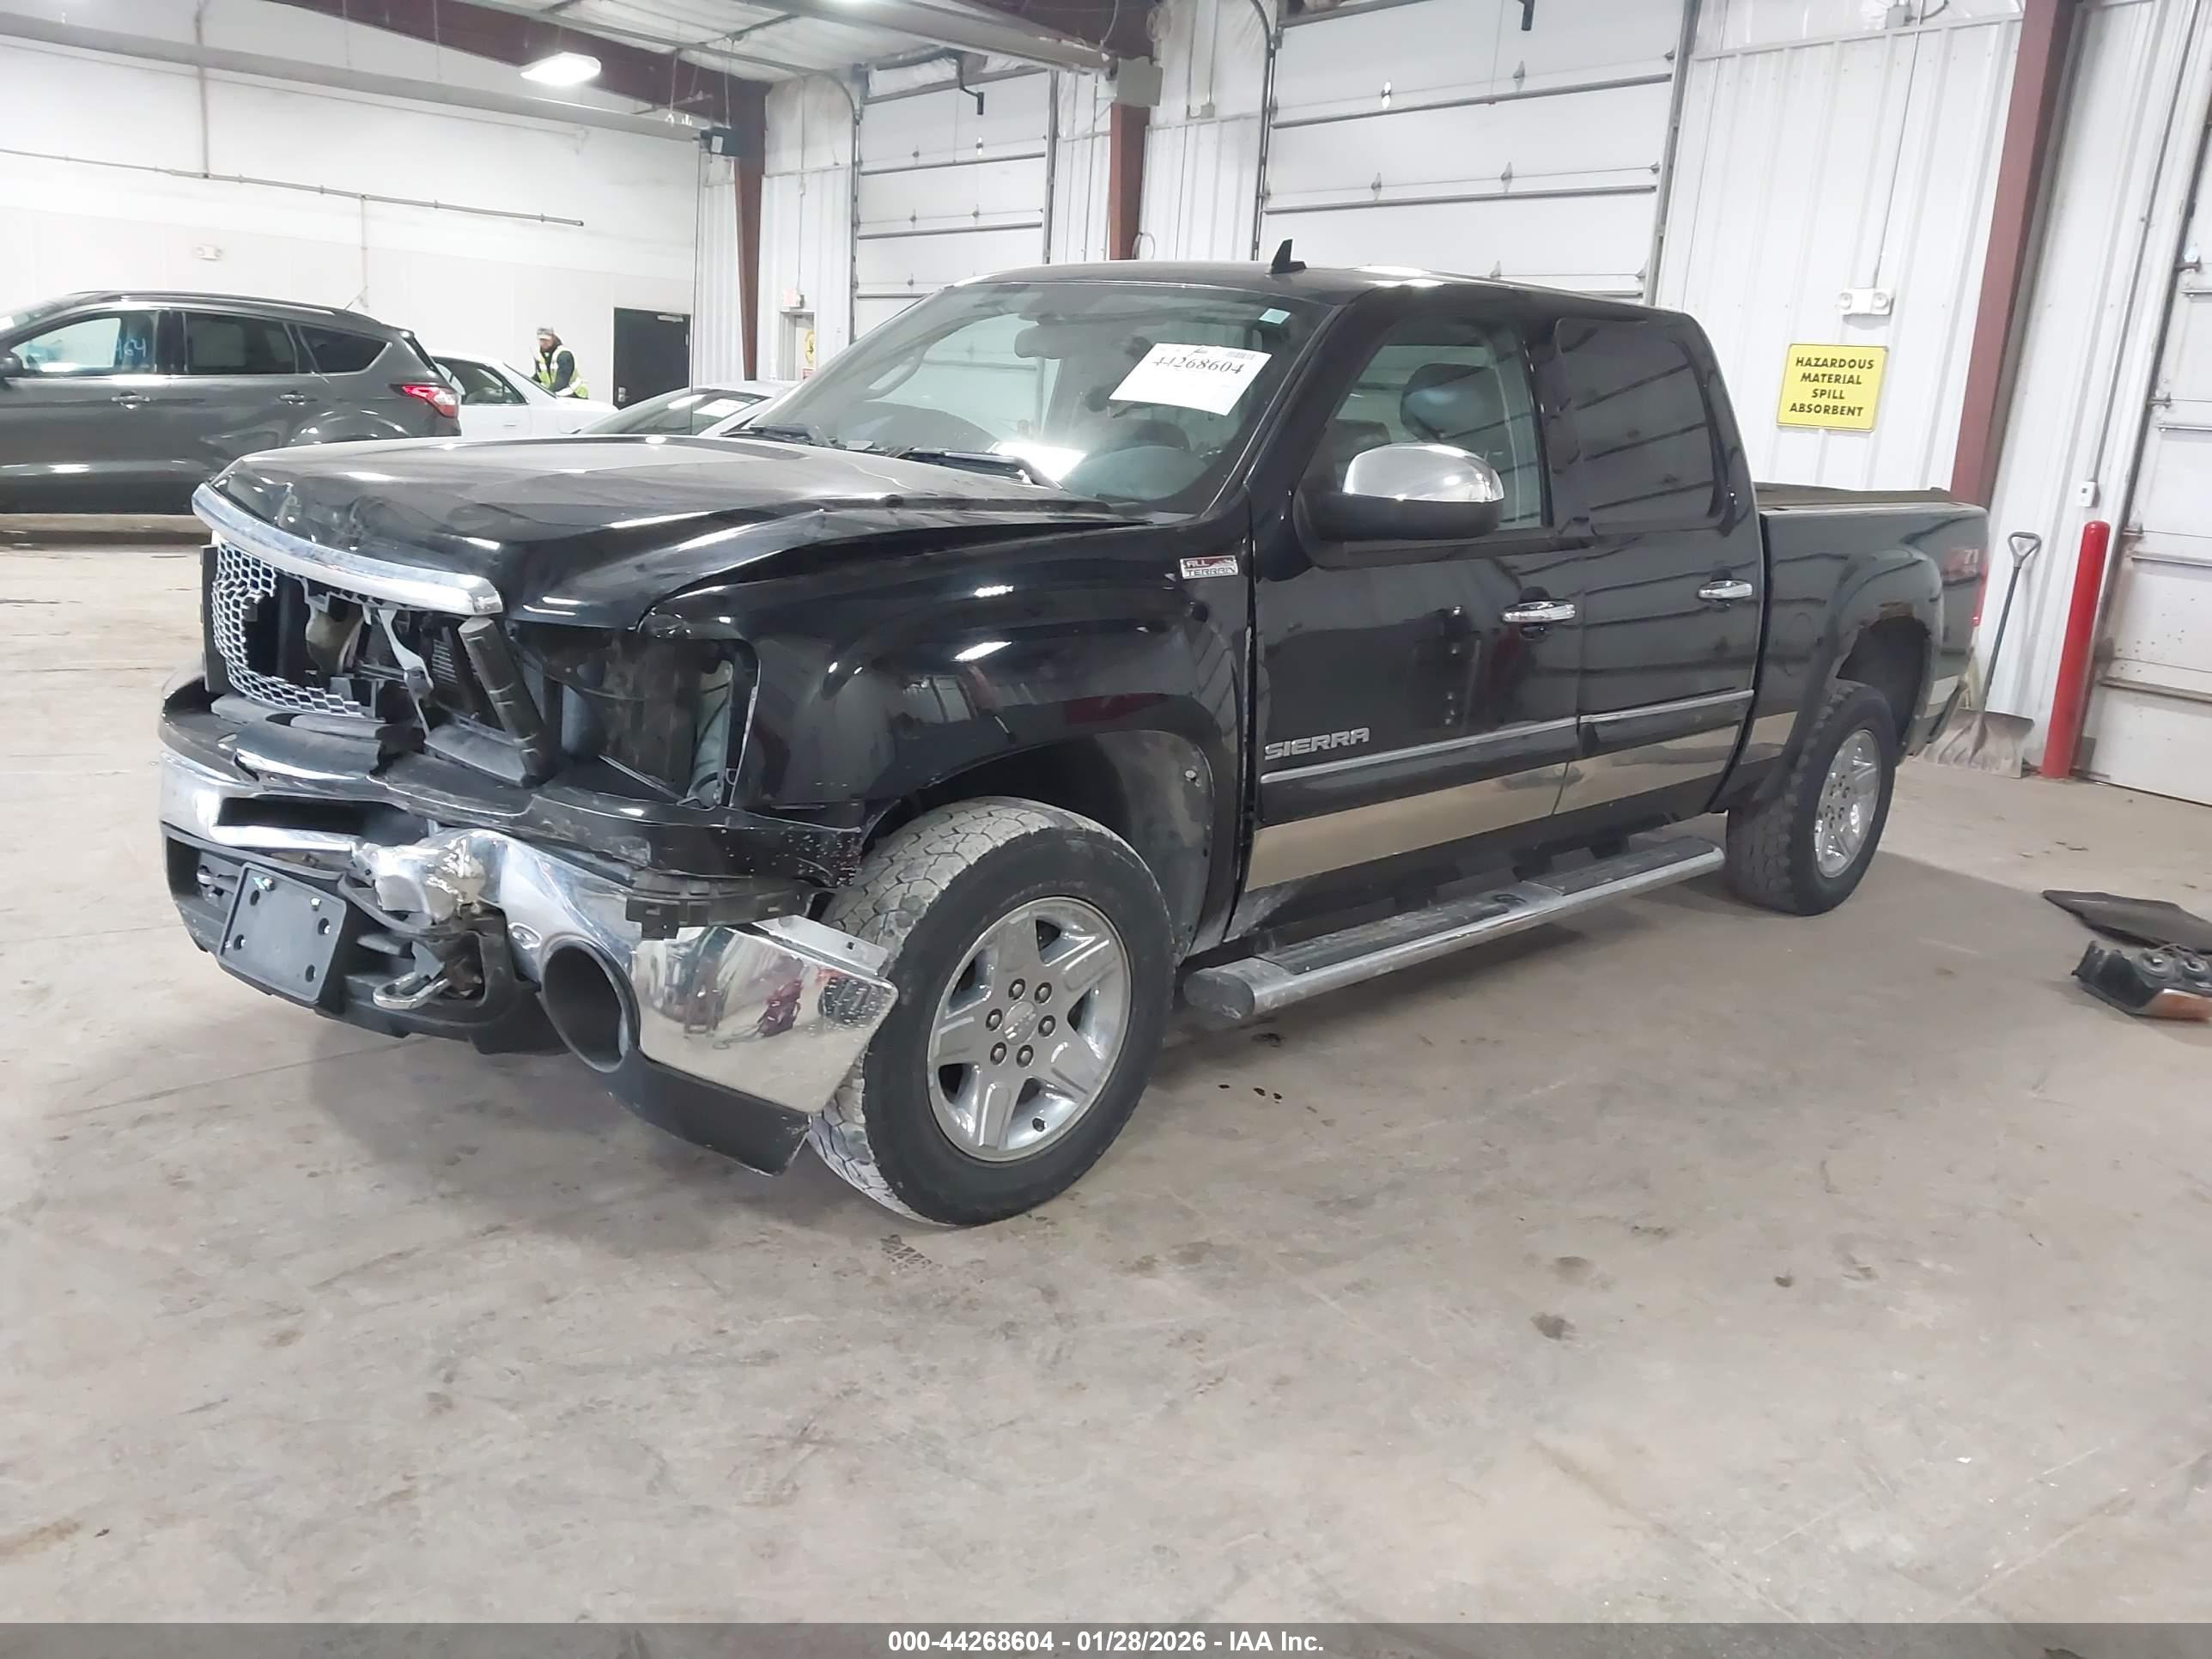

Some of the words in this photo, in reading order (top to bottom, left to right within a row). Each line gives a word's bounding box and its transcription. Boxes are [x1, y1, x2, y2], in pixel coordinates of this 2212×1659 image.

[1796, 356, 1875, 369] HAZARDOUS
[1800, 373, 1863, 385] MATERIAL
[1811, 388, 1845, 399] SPILL
[1789, 402, 1864, 416] ABSORBENT
[1186, 559, 1211, 568] ALL
[1186, 567, 1237, 578] TERRAIN
[1265, 727, 1370, 761] SIERRA
